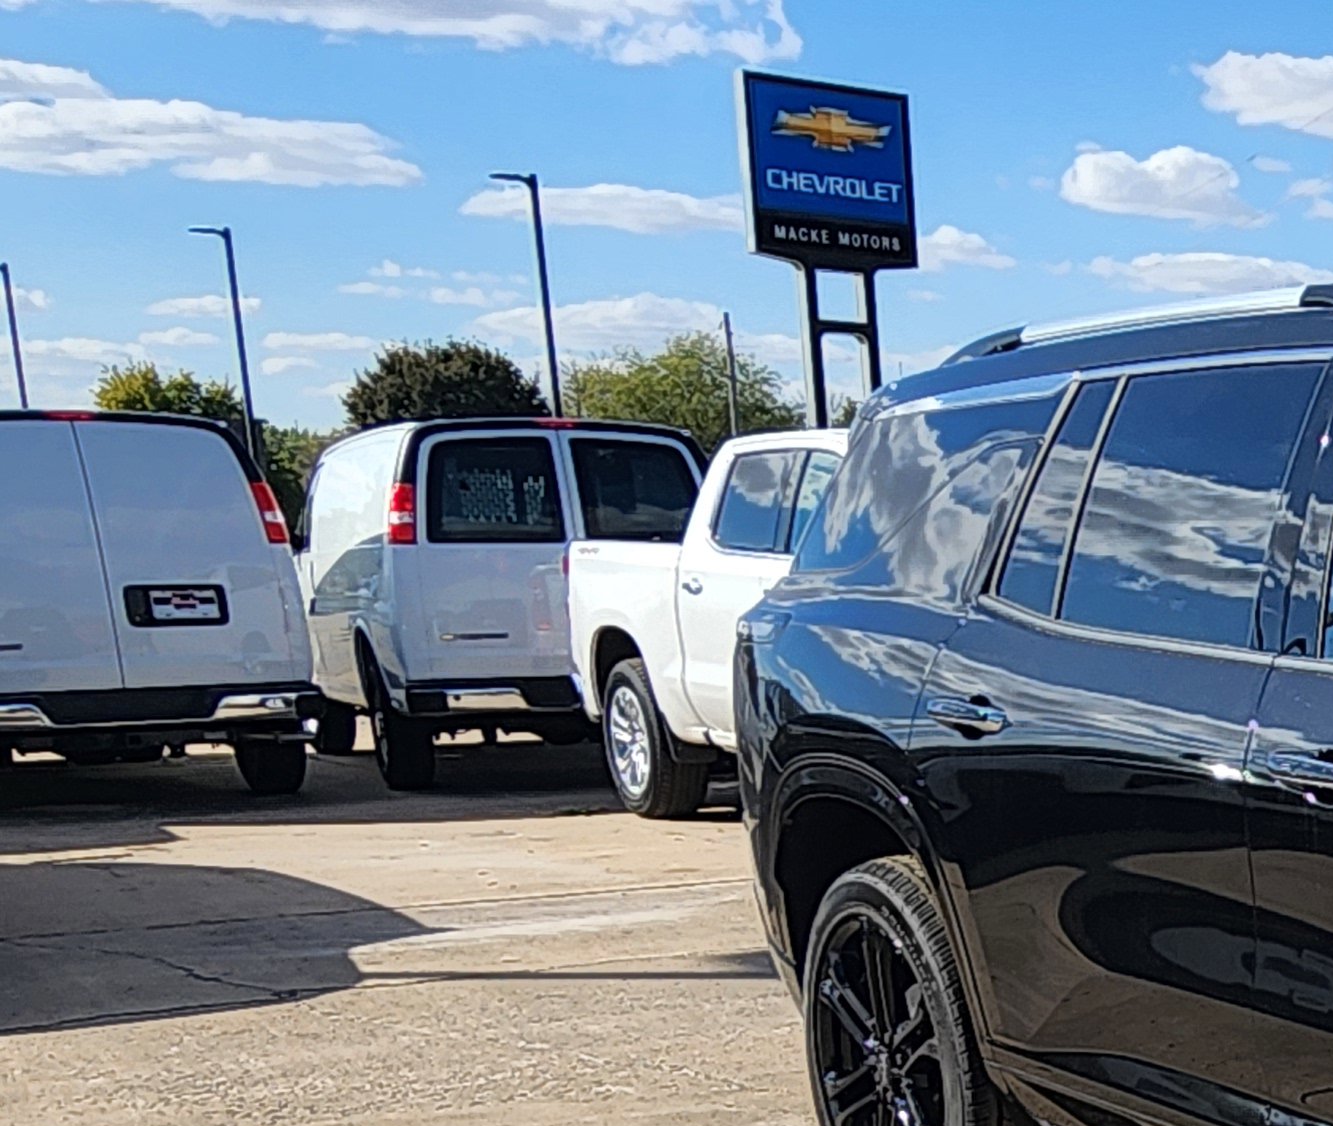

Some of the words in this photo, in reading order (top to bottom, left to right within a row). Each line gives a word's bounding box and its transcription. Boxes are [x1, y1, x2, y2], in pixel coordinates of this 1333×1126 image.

[766, 168, 902, 202] CHEVROLET
[774, 224, 830, 244] MACKE
[838, 231, 901, 251] MOTORS
